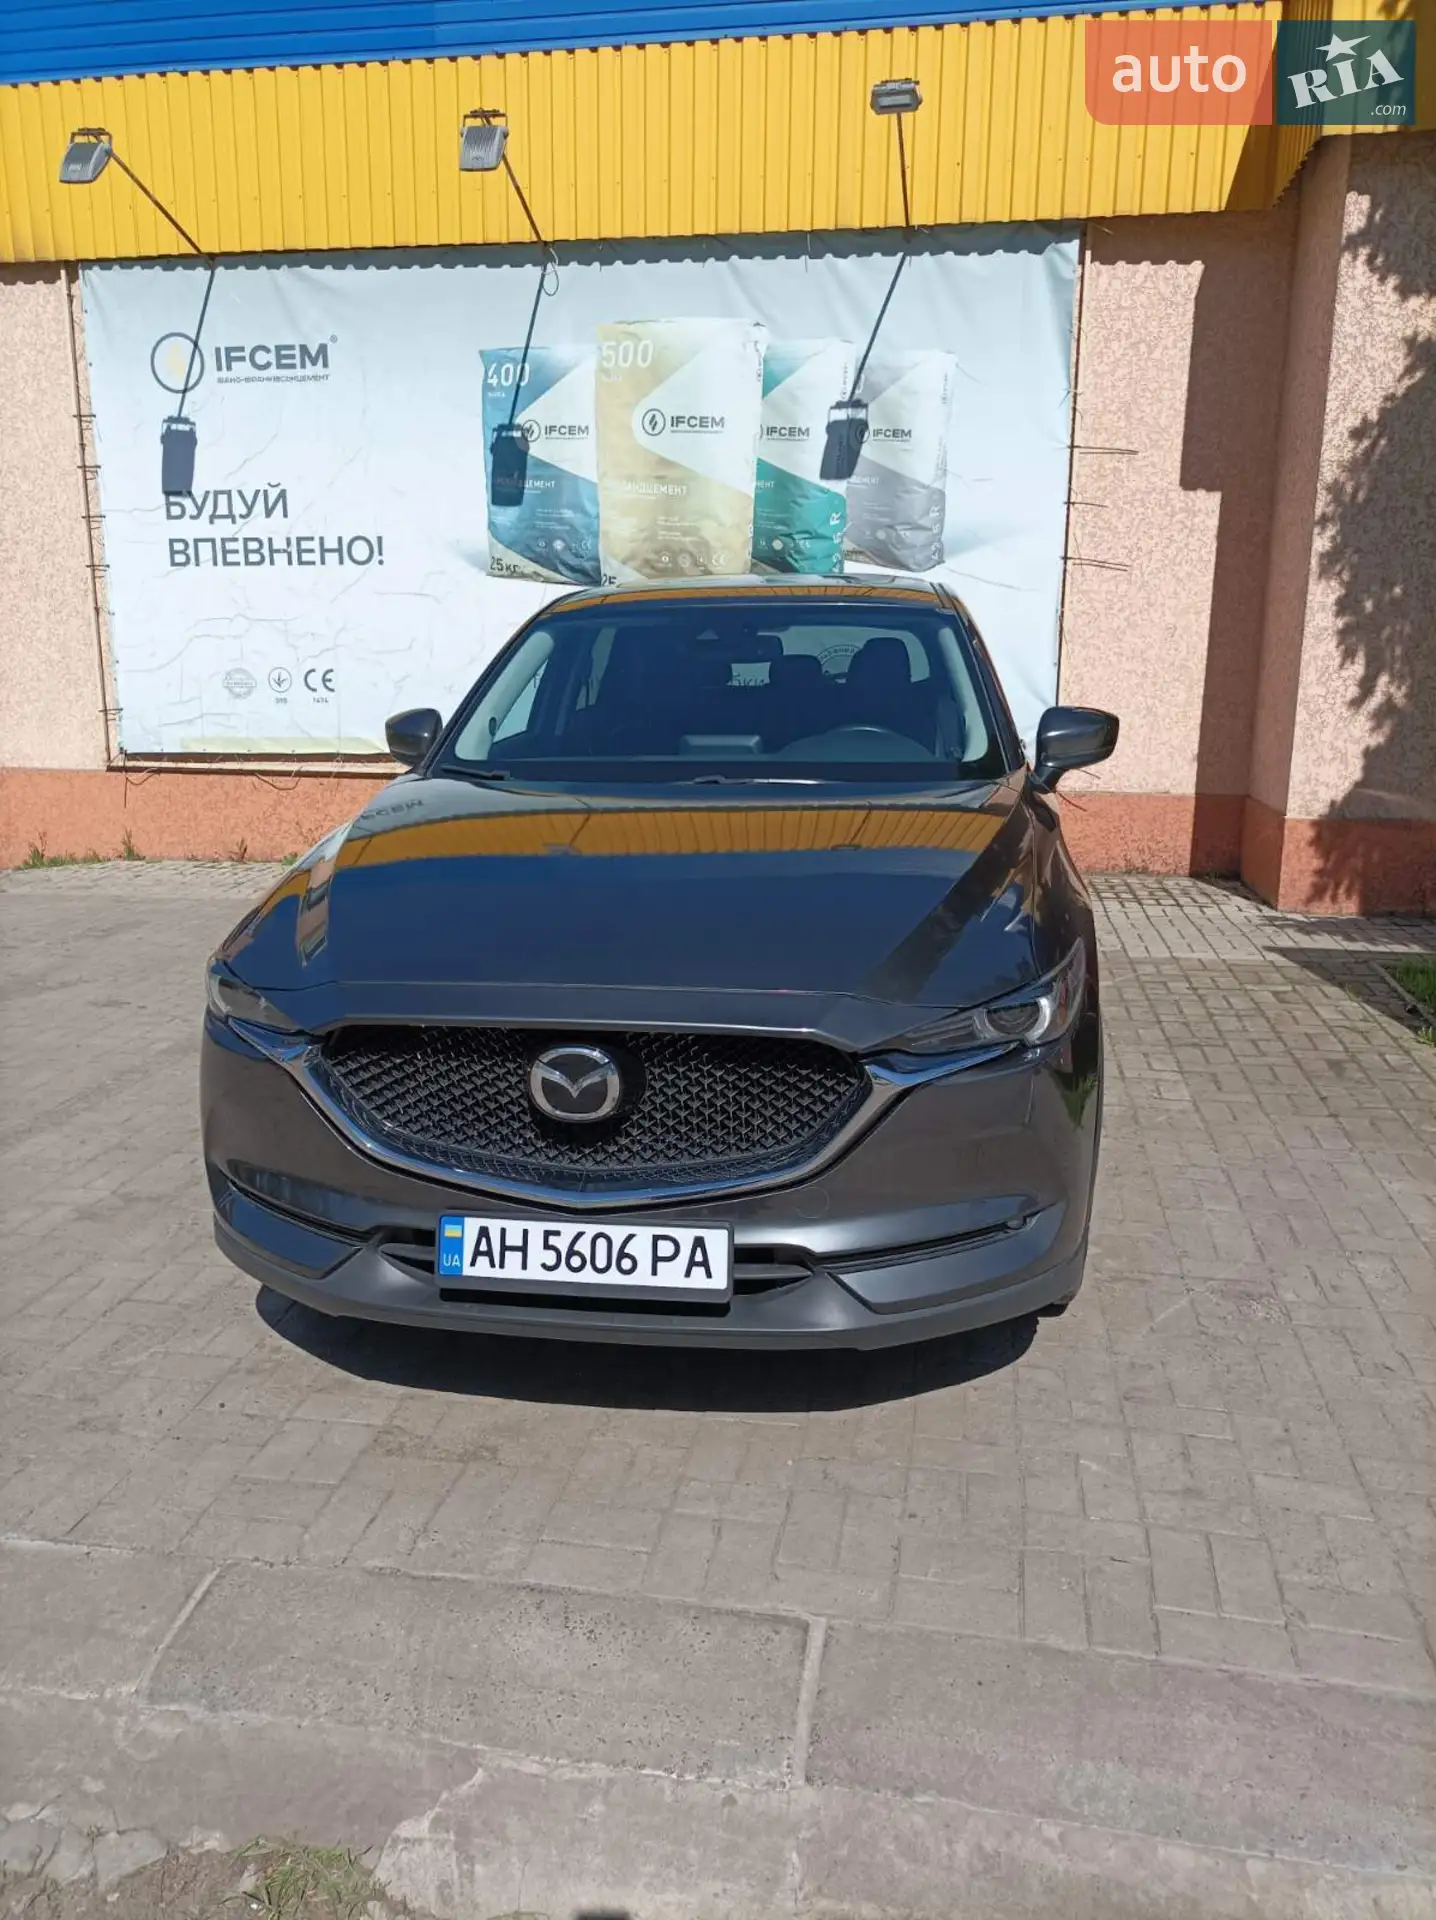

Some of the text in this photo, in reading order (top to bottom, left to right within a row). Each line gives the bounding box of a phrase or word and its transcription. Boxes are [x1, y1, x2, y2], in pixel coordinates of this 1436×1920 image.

[214, 342, 330, 372] IFCEM
[602, 340, 653, 369] 500
[487, 362, 530, 388] 400
[544, 425, 589, 436] IFCEM
[671, 415, 725, 429] IFCEM
[766, 425, 810, 438] IFCEM
[873, 427, 912, 439] IFCEM
[165, 482, 288, 525] БУДУЙ
[168, 535, 385, 568] ВПЕВНЕНО!
[490, 556, 503, 572] 25
[443, 1254, 461, 1268] UA
[469, 1225, 714, 1279] AH 5606 PA
